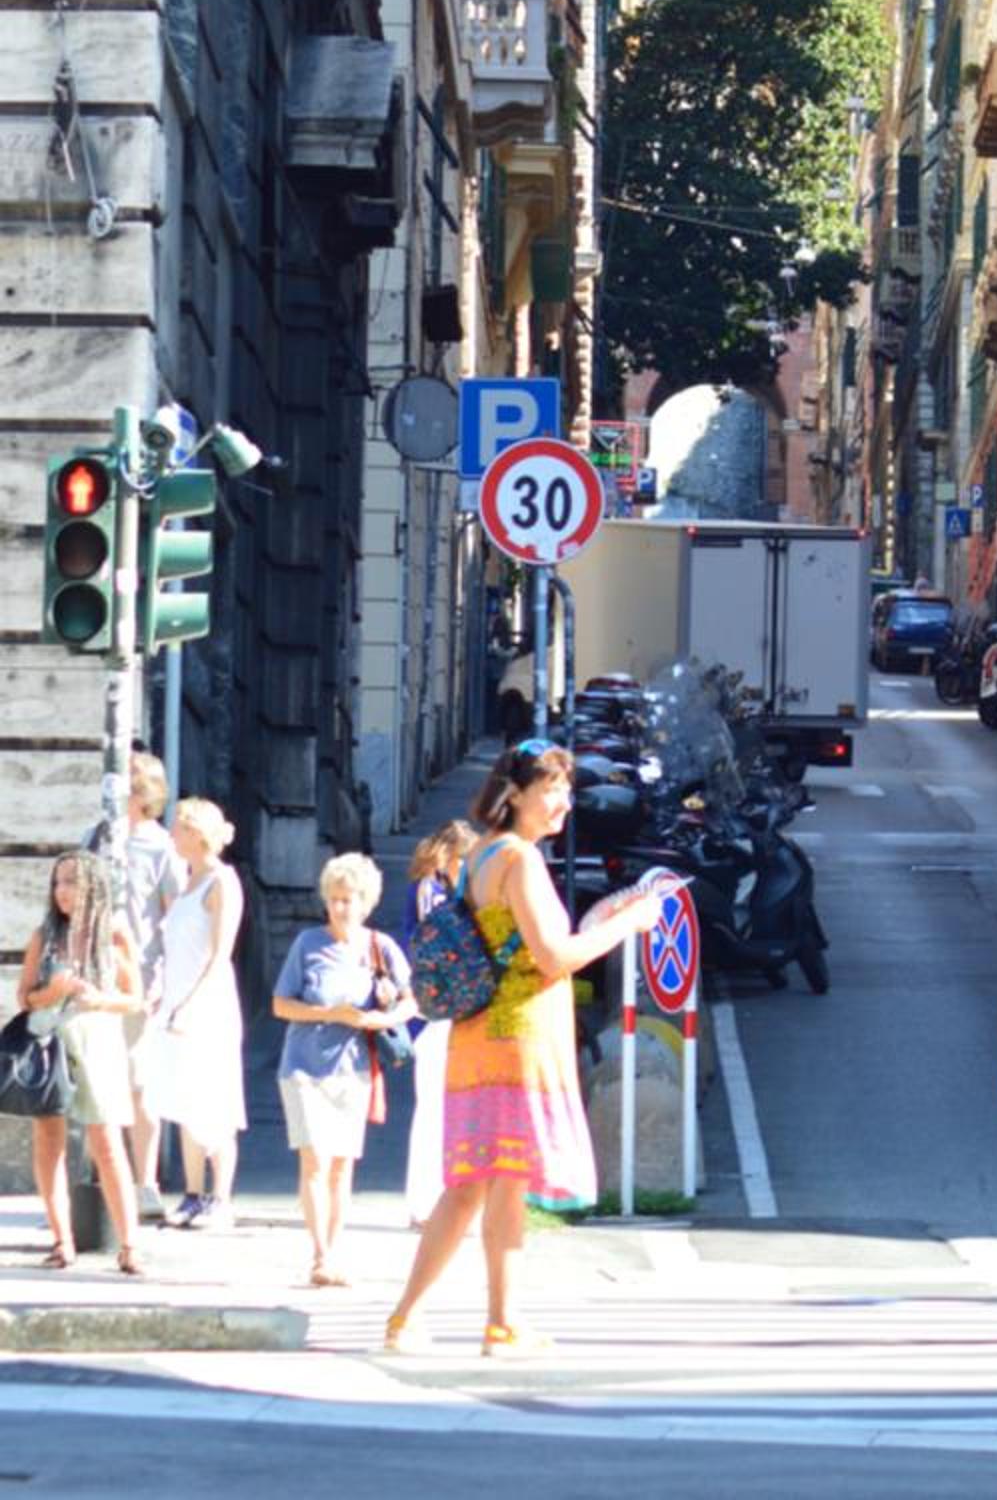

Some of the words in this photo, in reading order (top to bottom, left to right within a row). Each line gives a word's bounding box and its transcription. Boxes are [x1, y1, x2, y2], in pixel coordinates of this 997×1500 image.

[479, 389, 539, 467] P
[511, 475, 572, 532] 30
[637, 468, 654, 491] P
